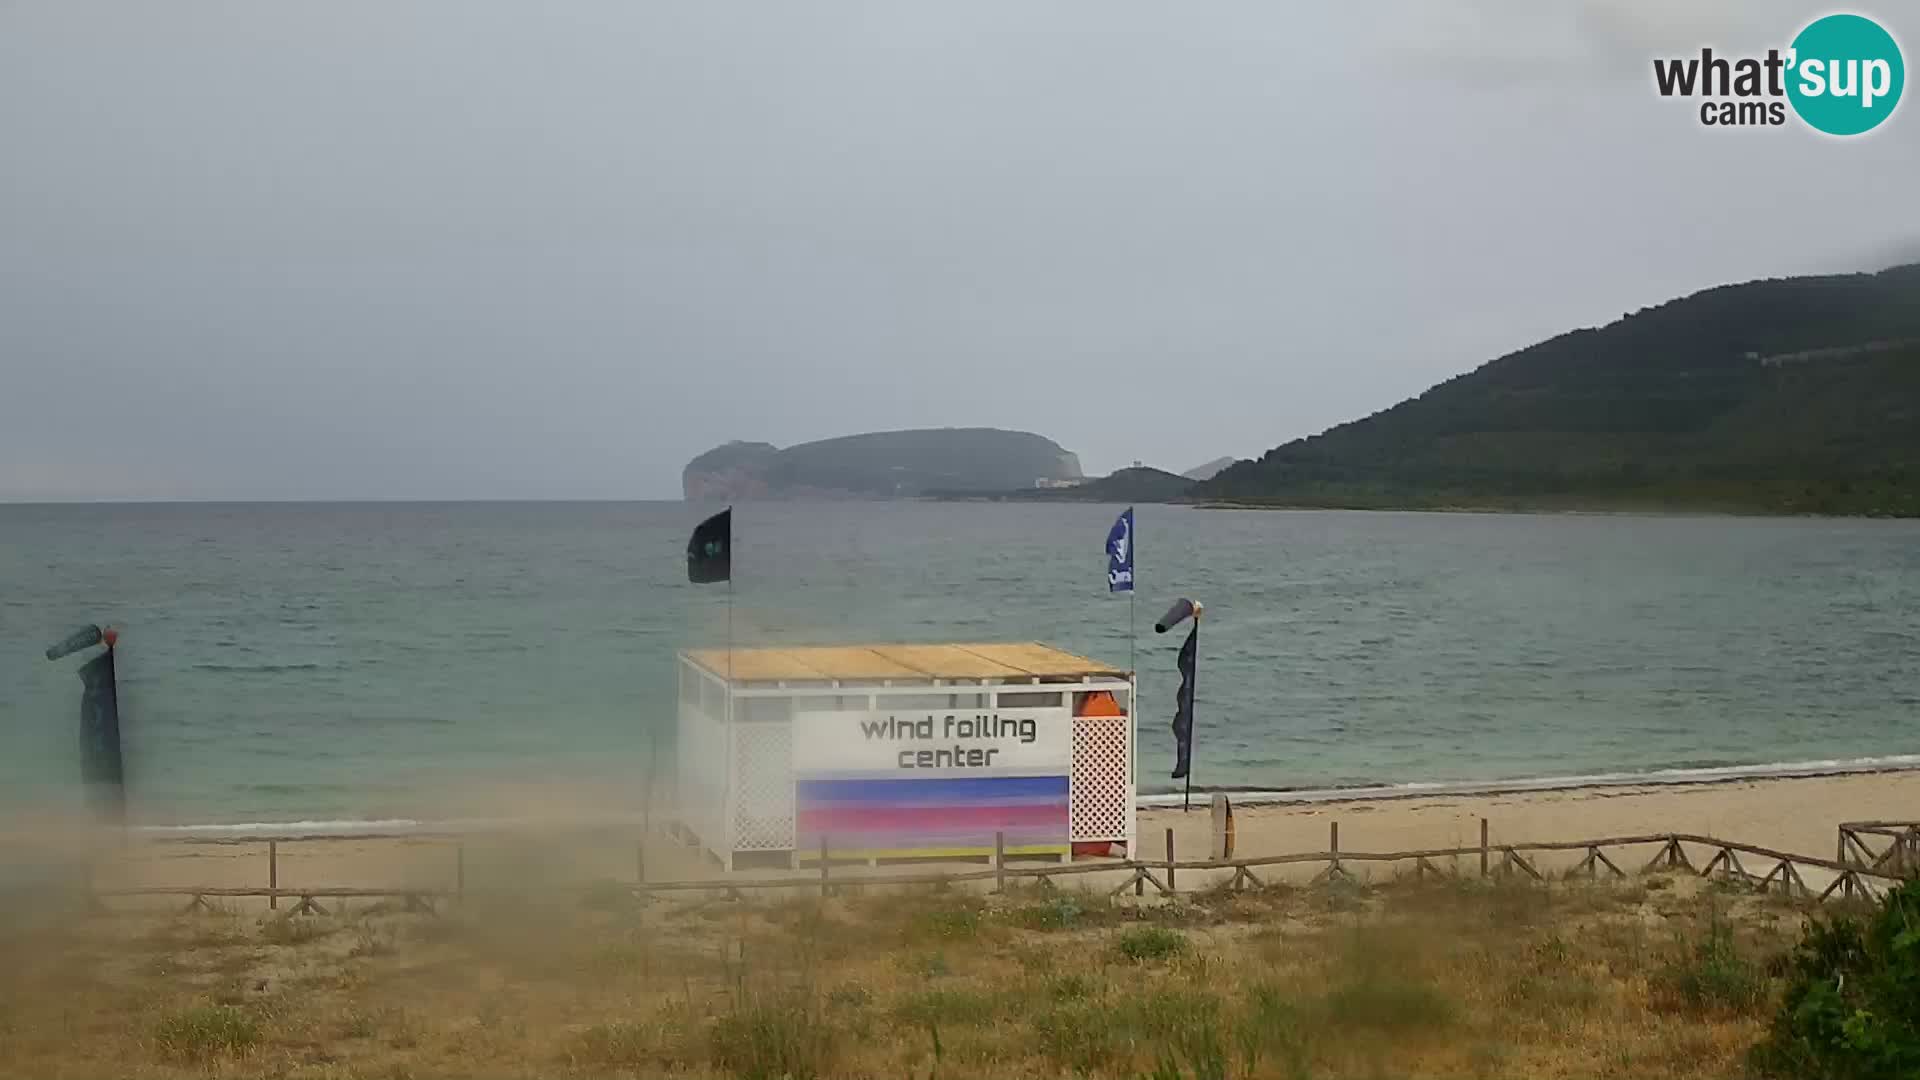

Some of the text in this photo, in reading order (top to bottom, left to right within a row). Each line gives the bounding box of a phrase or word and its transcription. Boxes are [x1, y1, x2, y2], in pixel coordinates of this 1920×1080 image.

[860, 714, 1037, 744] wind foiling
[897, 744, 1000, 769] center
